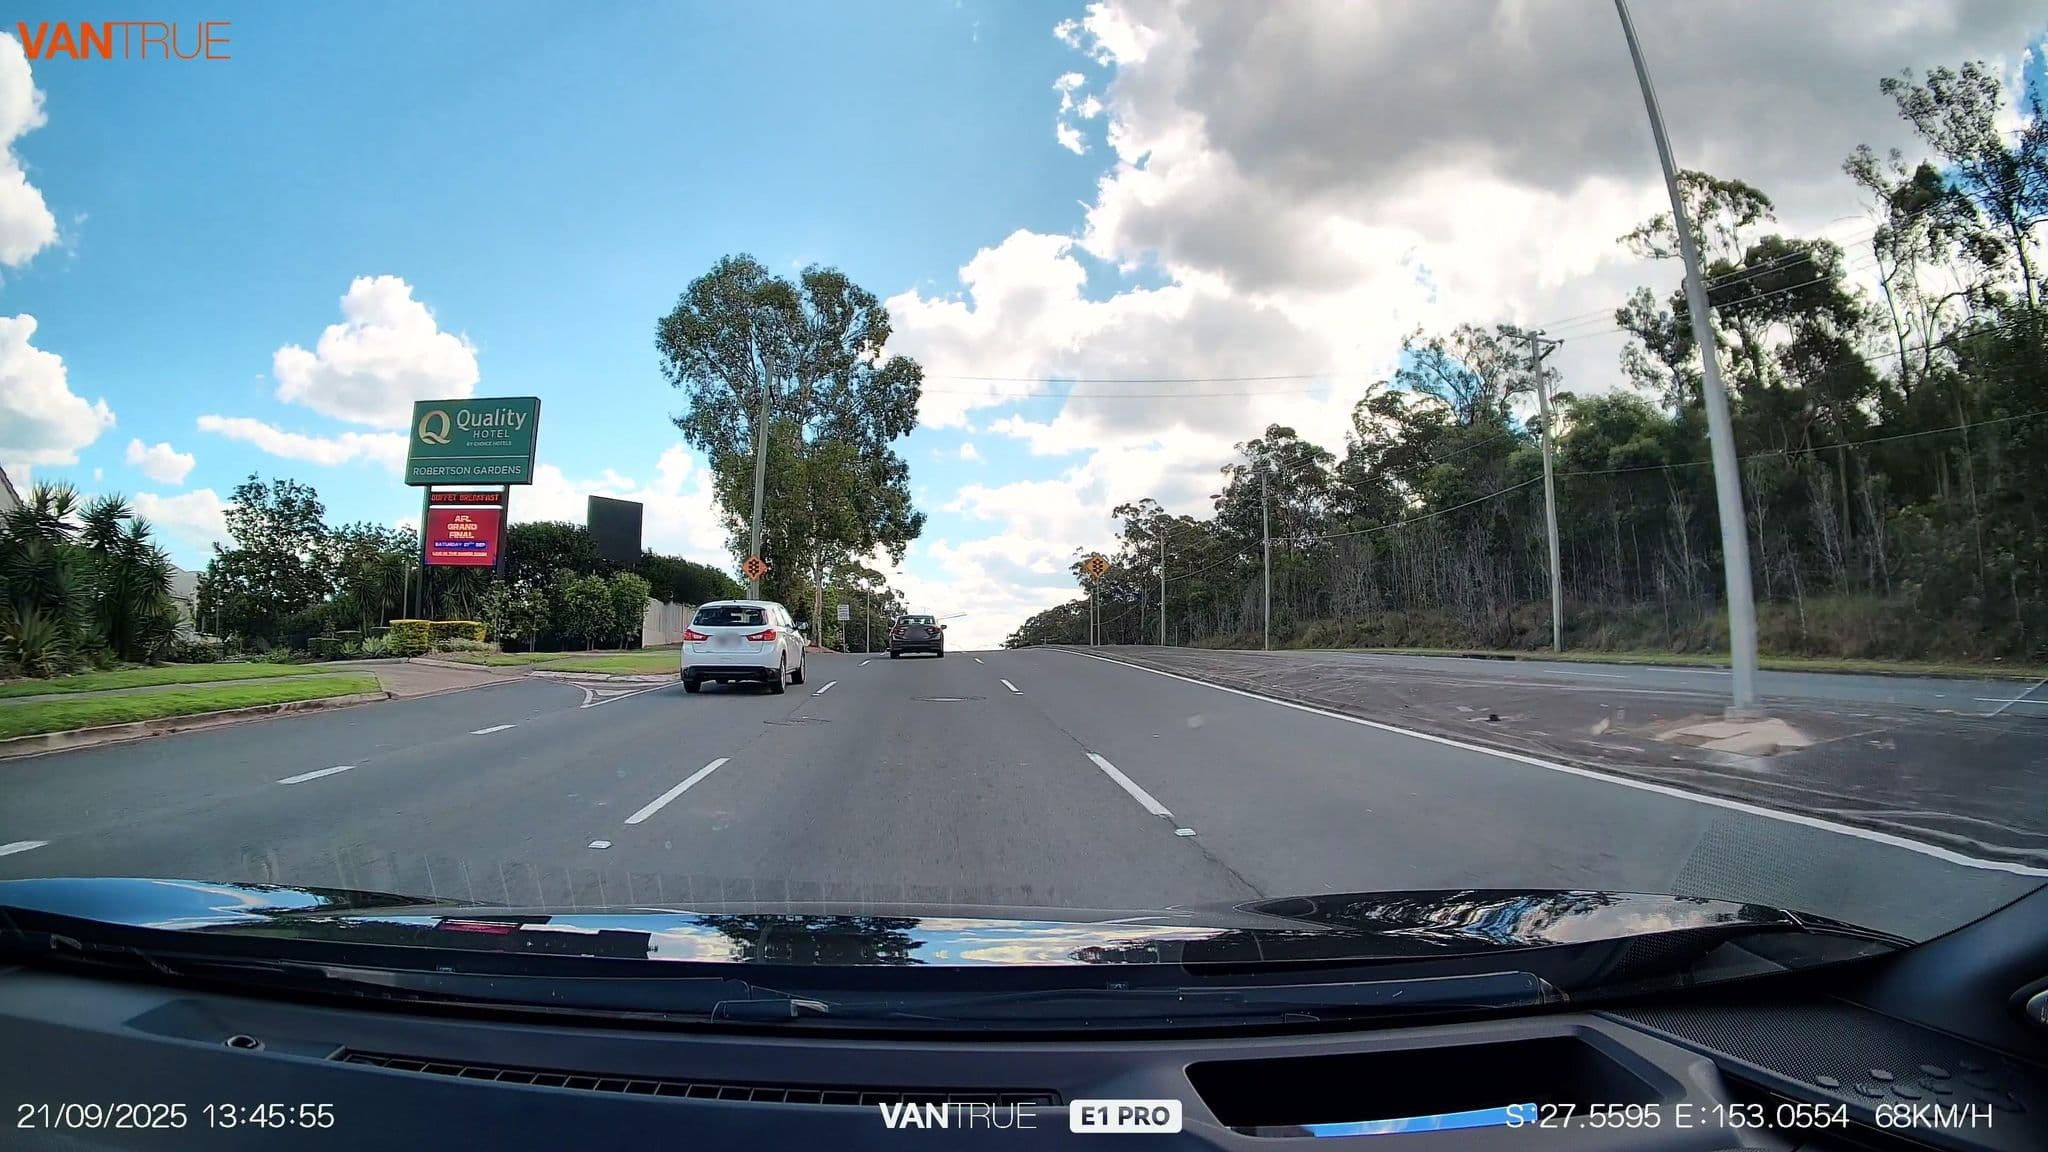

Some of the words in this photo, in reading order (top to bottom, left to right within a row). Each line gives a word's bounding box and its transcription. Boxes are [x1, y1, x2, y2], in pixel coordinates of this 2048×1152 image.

[456, 408, 528, 431] Quality
[473, 429, 510, 438] HOTEL
[412, 466, 471, 476] ROBERTSON
[473, 465, 521, 475] GARDENS
[454, 515, 472, 523] AFL
[447, 523, 478, 531] GRAND
[448, 531, 475, 539] FINAL
